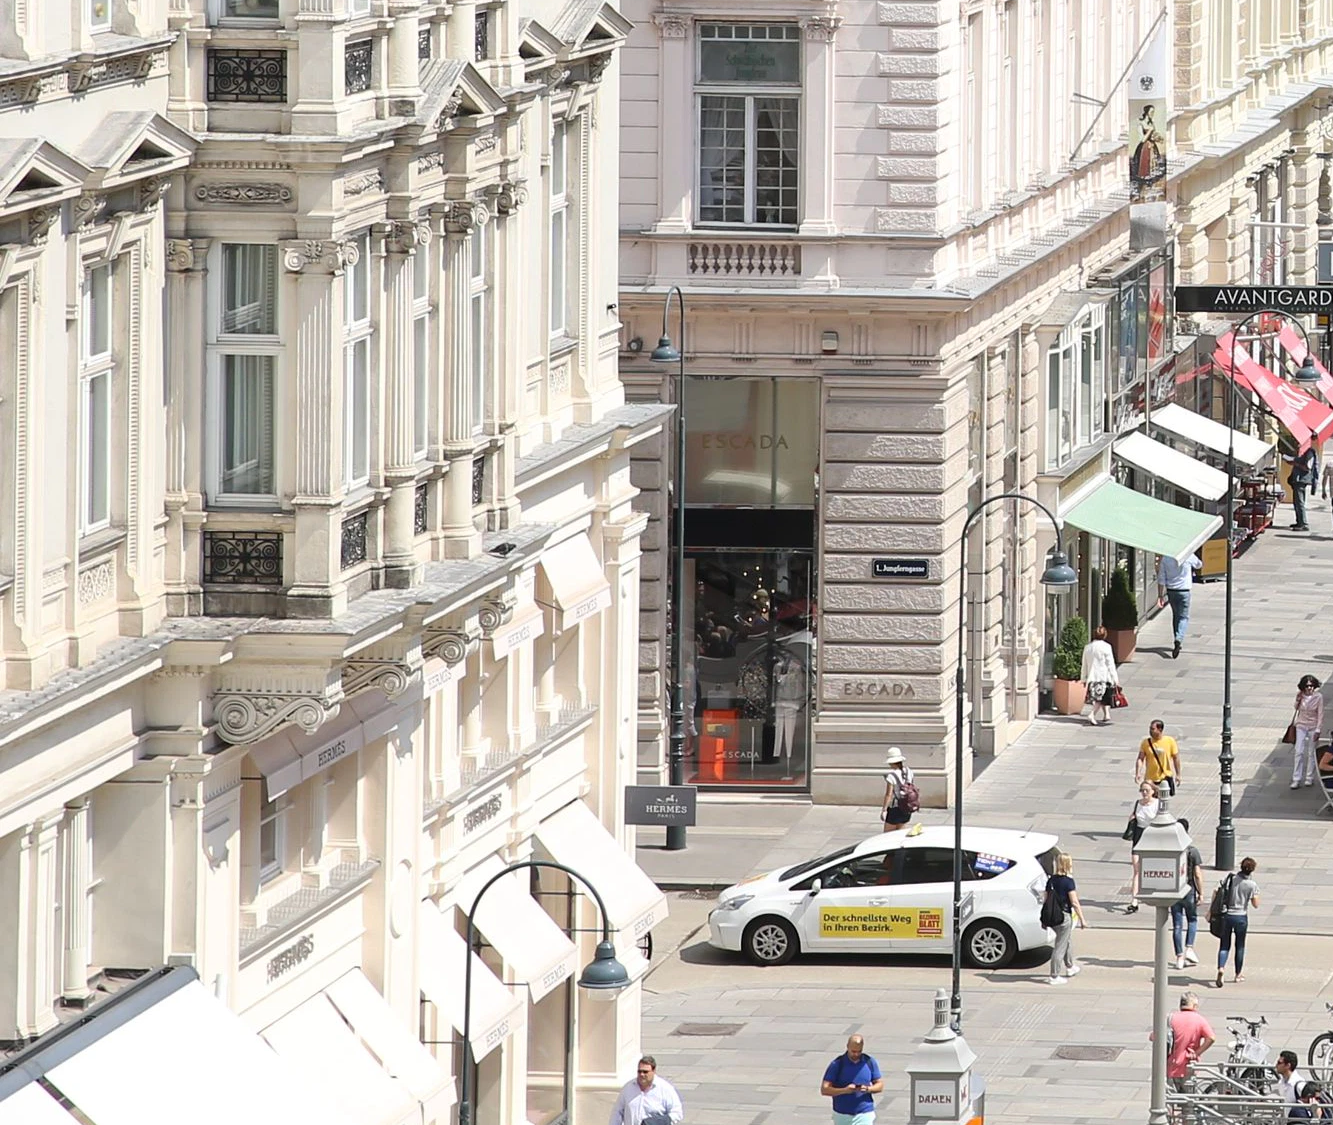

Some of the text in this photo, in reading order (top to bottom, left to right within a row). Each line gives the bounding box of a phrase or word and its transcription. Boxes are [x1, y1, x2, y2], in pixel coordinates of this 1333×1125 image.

[702, 434, 789, 450] ESCADA
[843, 683, 917, 697] ESCADA
[1143, 870, 1174, 878] HERREN
[823, 913, 912, 924] Der schnellste Weg
[823, 923, 894, 933] in Ihren Bezirk.
[918, 1094, 952, 1104] DAMEN
